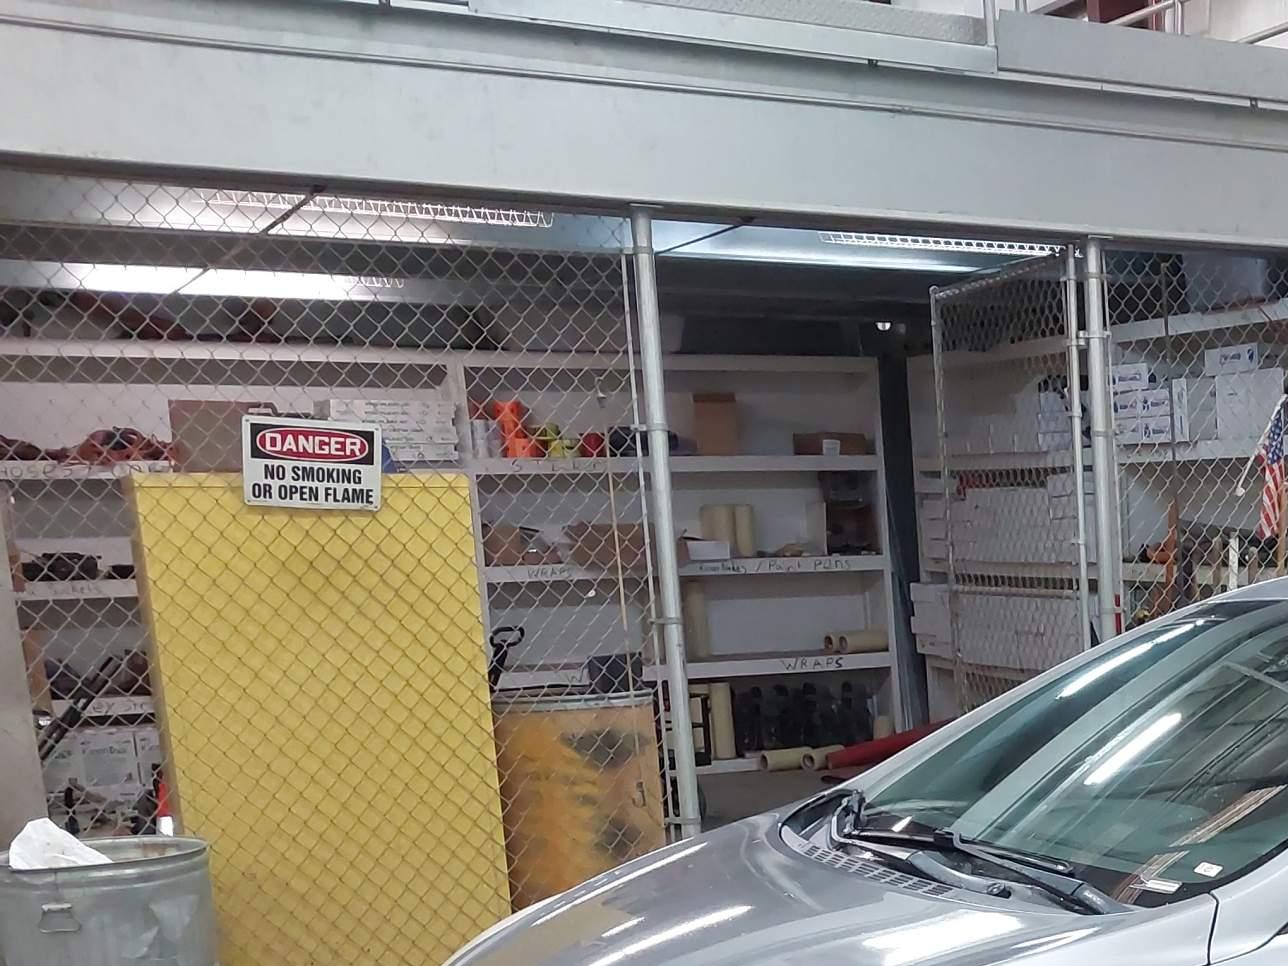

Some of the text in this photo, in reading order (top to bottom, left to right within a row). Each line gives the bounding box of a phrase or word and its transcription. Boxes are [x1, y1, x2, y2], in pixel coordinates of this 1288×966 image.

[265, 432, 361, 456] DANGER
[264, 463, 362, 485] NO SMOKING
[252, 482, 374, 505] OR OPEN FLAME
[781, 657, 844, 670] WRAPS
